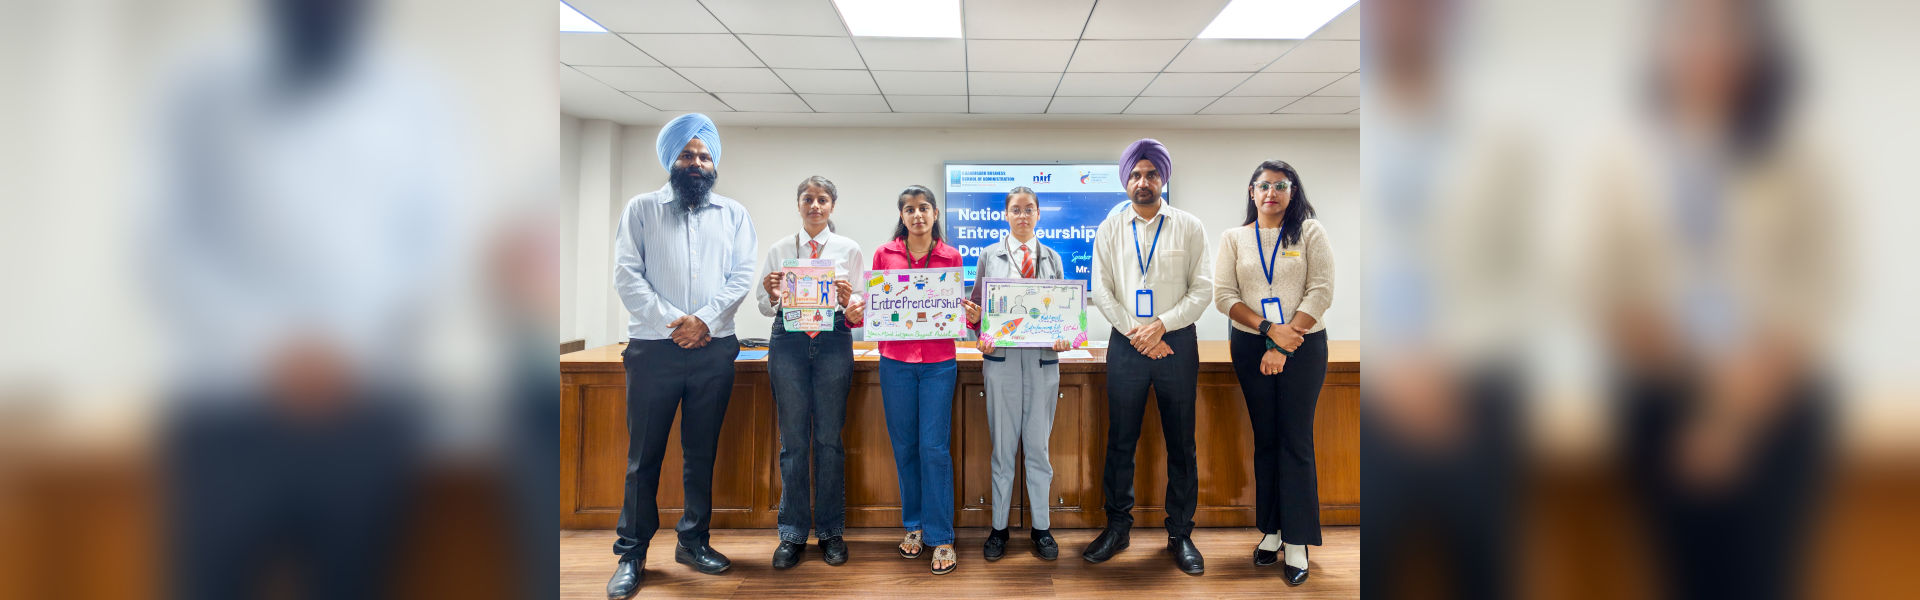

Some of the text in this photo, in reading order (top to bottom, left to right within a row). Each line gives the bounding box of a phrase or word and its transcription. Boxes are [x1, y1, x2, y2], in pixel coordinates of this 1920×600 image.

[1033, 172, 1052, 182] nirf
[958, 208, 1006, 220] Nation
[958, 226, 1096, 242] Entrepeurship
